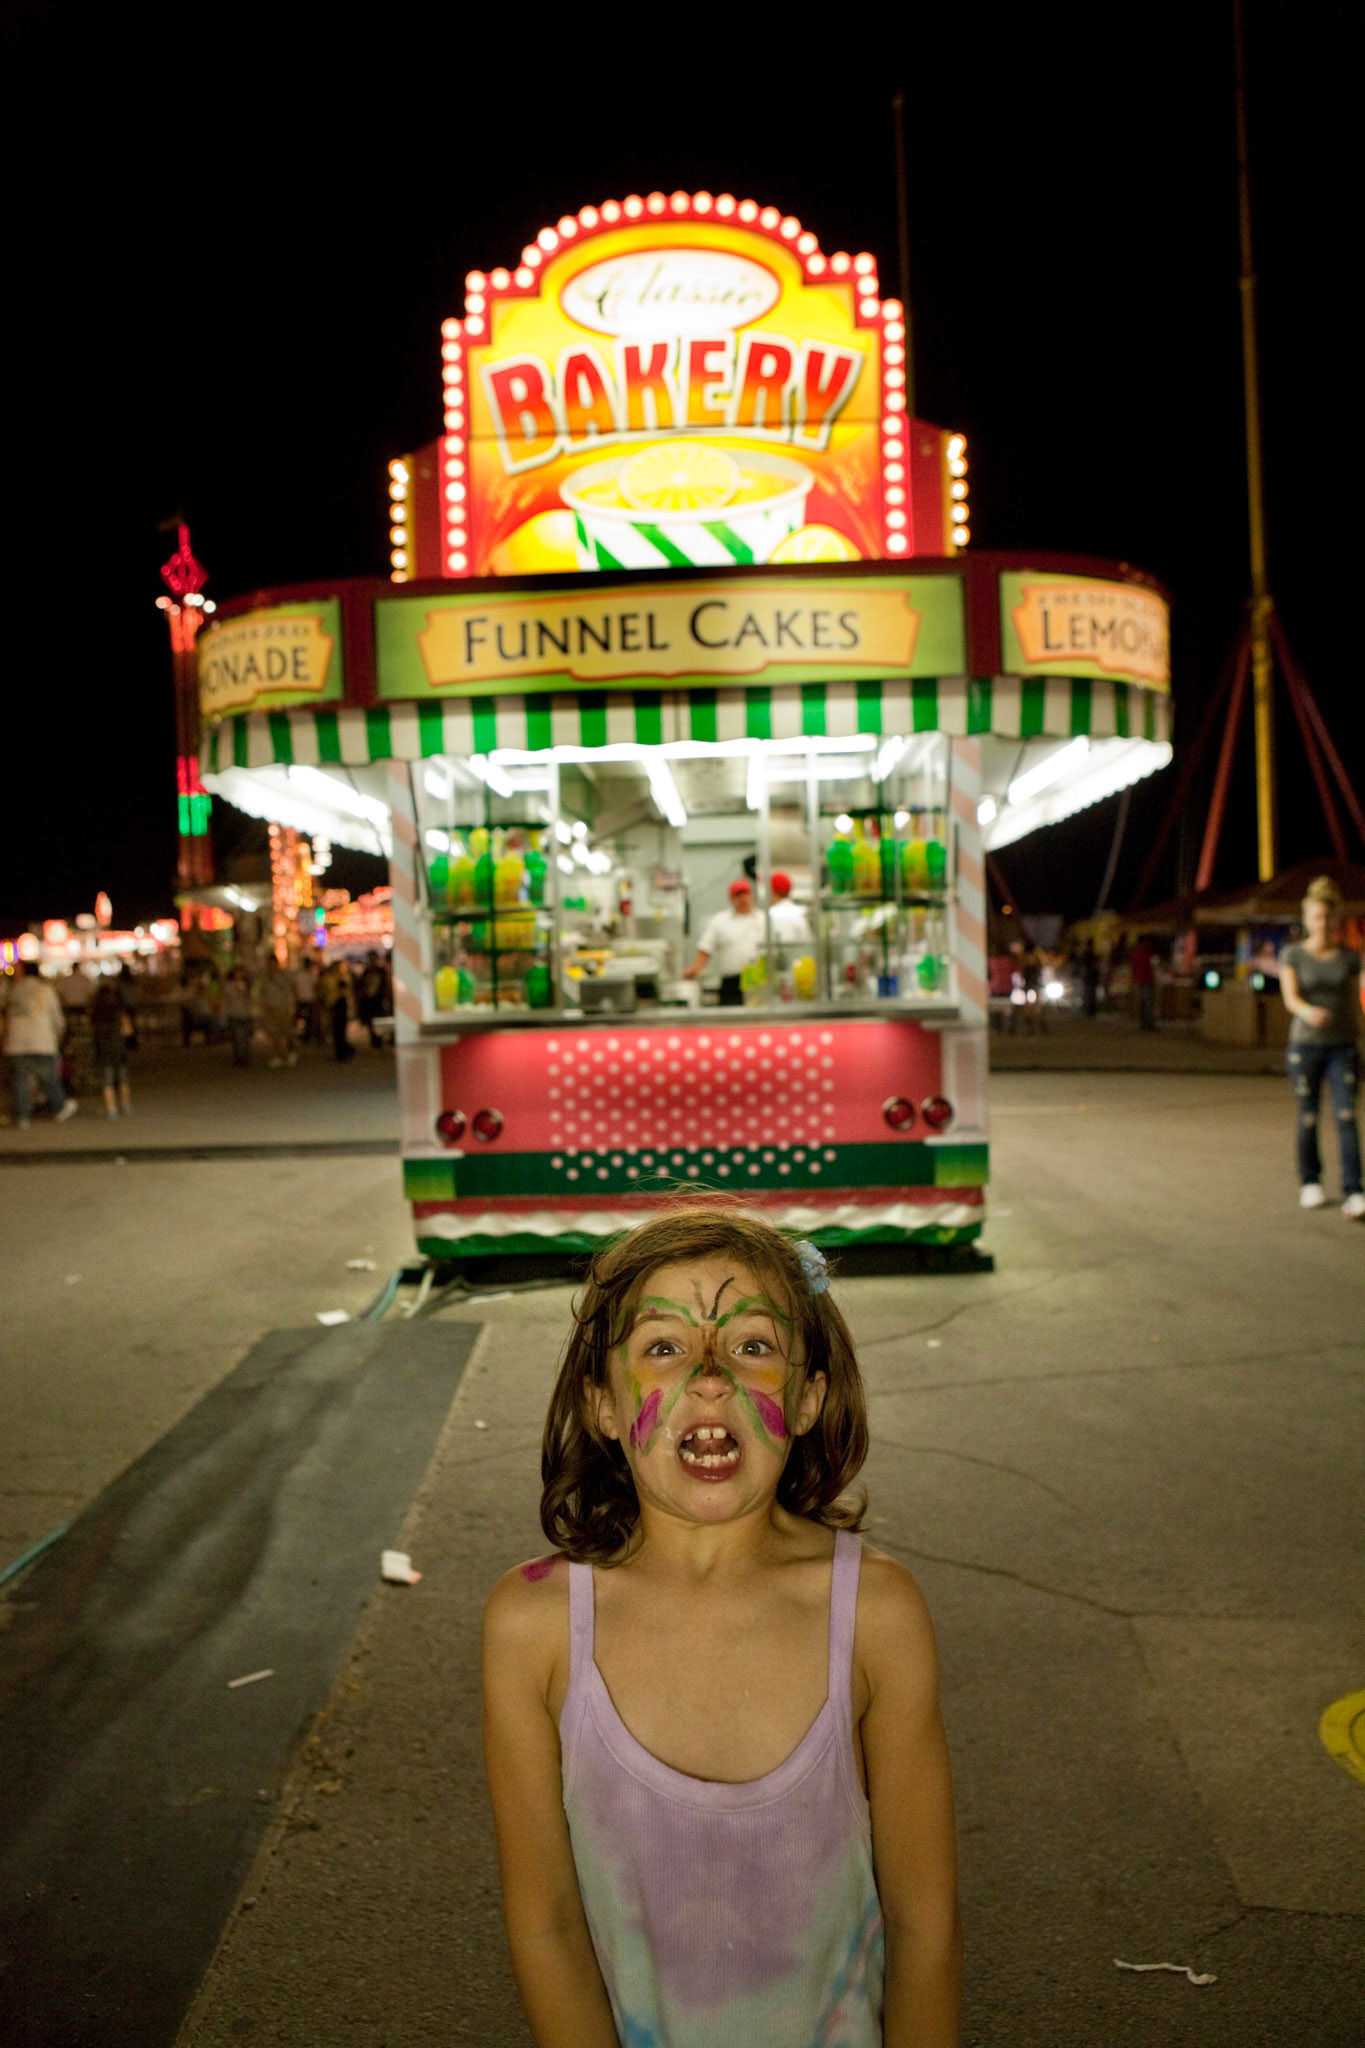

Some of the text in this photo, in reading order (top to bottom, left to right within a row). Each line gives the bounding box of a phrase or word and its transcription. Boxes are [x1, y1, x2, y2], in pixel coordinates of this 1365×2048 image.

[484, 334, 864, 474] BAKERY
[464, 602, 860, 665] FUNNEL CAKES
[203, 646, 309, 693] ONADE
